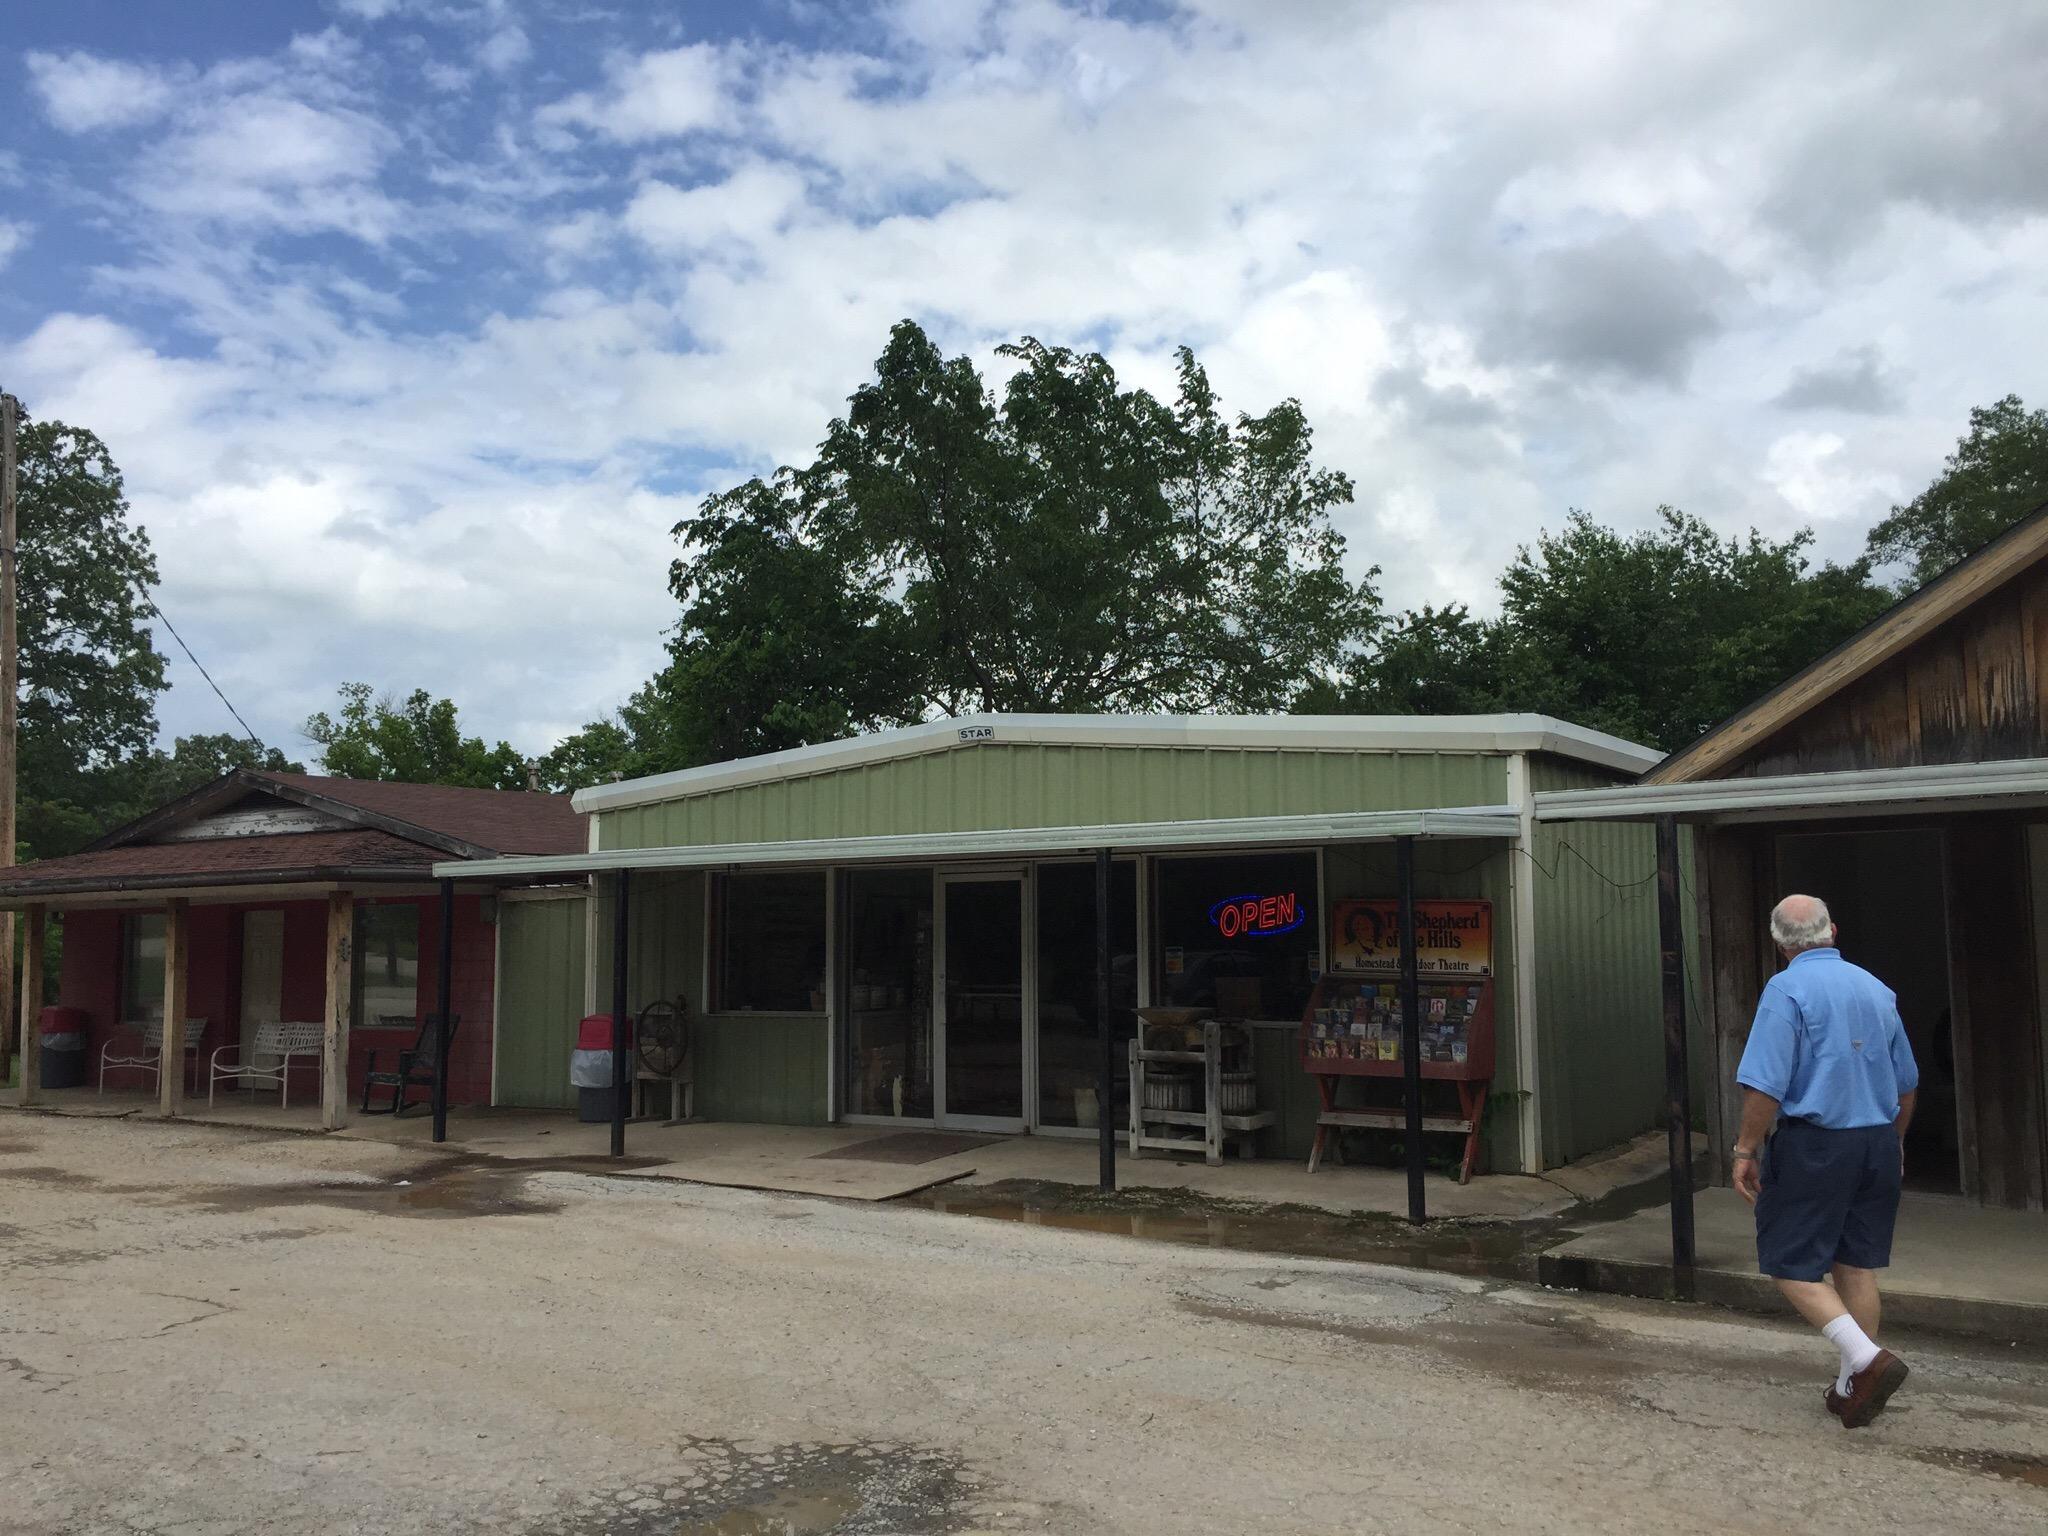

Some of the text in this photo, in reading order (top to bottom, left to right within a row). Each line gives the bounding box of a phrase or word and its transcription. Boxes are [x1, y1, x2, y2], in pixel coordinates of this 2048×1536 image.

[960, 728, 992, 739] STAR
[1219, 892, 1295, 937] OPEN
[1415, 911, 1479, 930] Shepherd
[1386, 928, 1399, 947] of
[1428, 928, 1462, 949] Hills
[1355, 956, 1395, 969] Homestead
[1438, 958, 1470, 971] Theatre
